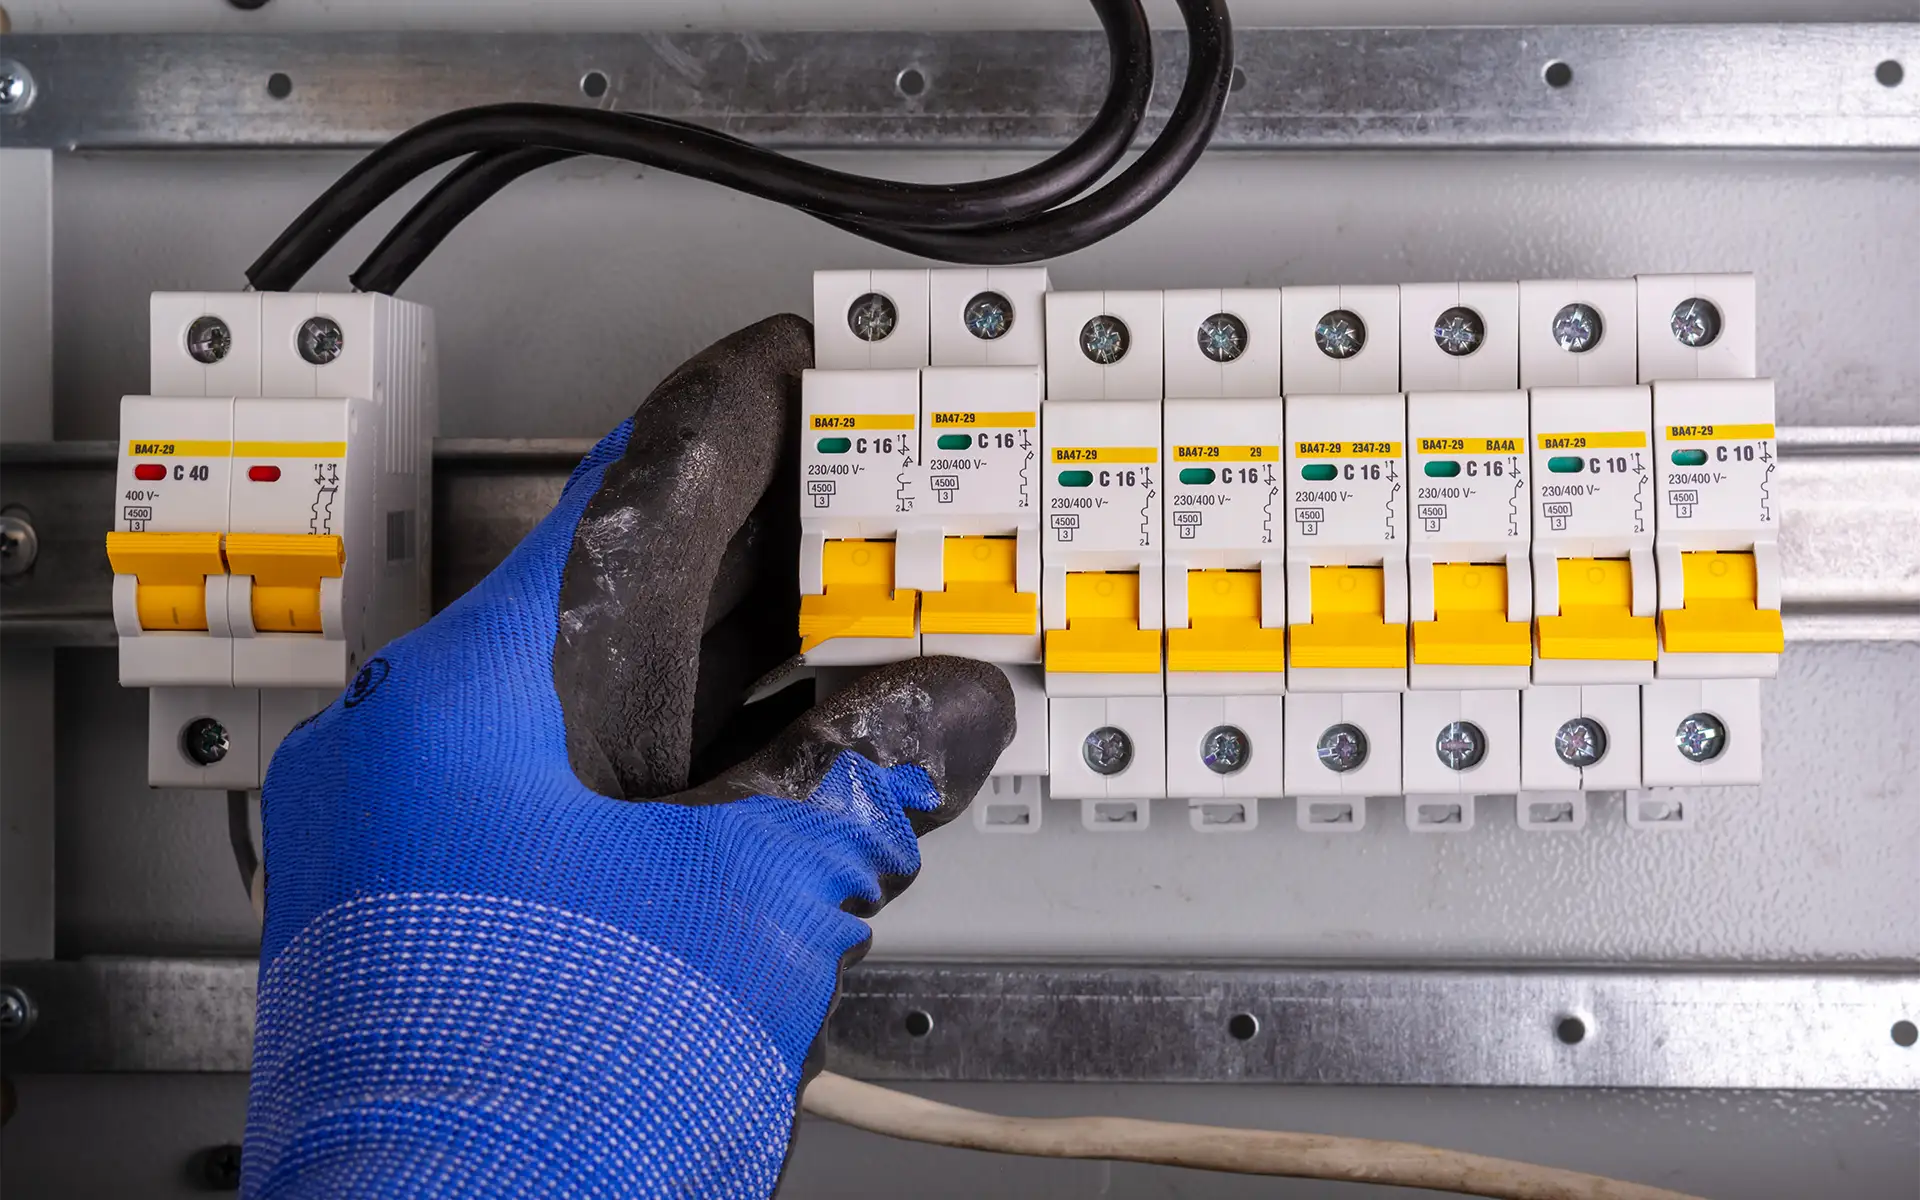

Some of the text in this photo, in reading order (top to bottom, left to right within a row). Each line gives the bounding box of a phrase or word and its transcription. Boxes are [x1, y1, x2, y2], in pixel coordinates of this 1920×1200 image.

[815, 418, 855, 427] BA47-29
[935, 414, 975, 423] BA47-29
[1672, 426, 1714, 436] BA47-29
[856, 438, 892, 453] C 16
[978, 433, 1014, 448] C 16
[1423, 440, 1515, 451] BA47-29 BA4A
[1545, 438, 1586, 448] BA47-29
[135, 444, 175, 454] BA47-29
[1178, 448, 1262, 457] BA47-29 29
[1300, 443, 1391, 453] BA47-29 2347-29
[1057, 450, 1097, 460] BA47-29
[1716, 445, 1754, 462] C 10
[327, 463, 332, 471] 3
[808, 465, 849, 475] 230/400
[930, 460, 971, 470] 230/400
[1466, 461, 1503, 476] C 16
[1590, 457, 1626, 474] C 10
[173, 465, 209, 481] C 40
[1221, 468, 1258, 484] C 16
[1344, 464, 1380, 480] C 16
[935, 479, 955, 487] 4500
[1099, 471, 1135, 487] C 16
[1668, 474, 1711, 484] 230/400
[811, 484, 832, 492] 4500
[1418, 488, 1460, 498] 230/400
[1542, 486, 1584, 496] 230/400
[125, 491, 144, 501] 400
[819, 496, 825, 505] 3
[942, 492, 949, 500] 3
[1173, 495, 1215, 505] 230/400
[1295, 492, 1337, 502] 230/400
[1673, 493, 1695, 502] 4500
[1051, 499, 1093, 509] 230/400
[127, 509, 148, 518] 4500
[1422, 508, 1443, 516] 4500
[1547, 505, 1569, 514] 4500
[1681, 506, 1688, 515] 3
[1177, 515, 1198, 523] 4500
[1299, 511, 1320, 520] 4500
[134, 522, 140, 530] 3
[1055, 518, 1076, 526] 4500
[1429, 520, 1436, 529] 3
[1555, 519, 1562, 527] 3
[1185, 527, 1191, 536] 3
[1307, 524, 1313, 532] 3
[1062, 531, 1069, 539] 3
